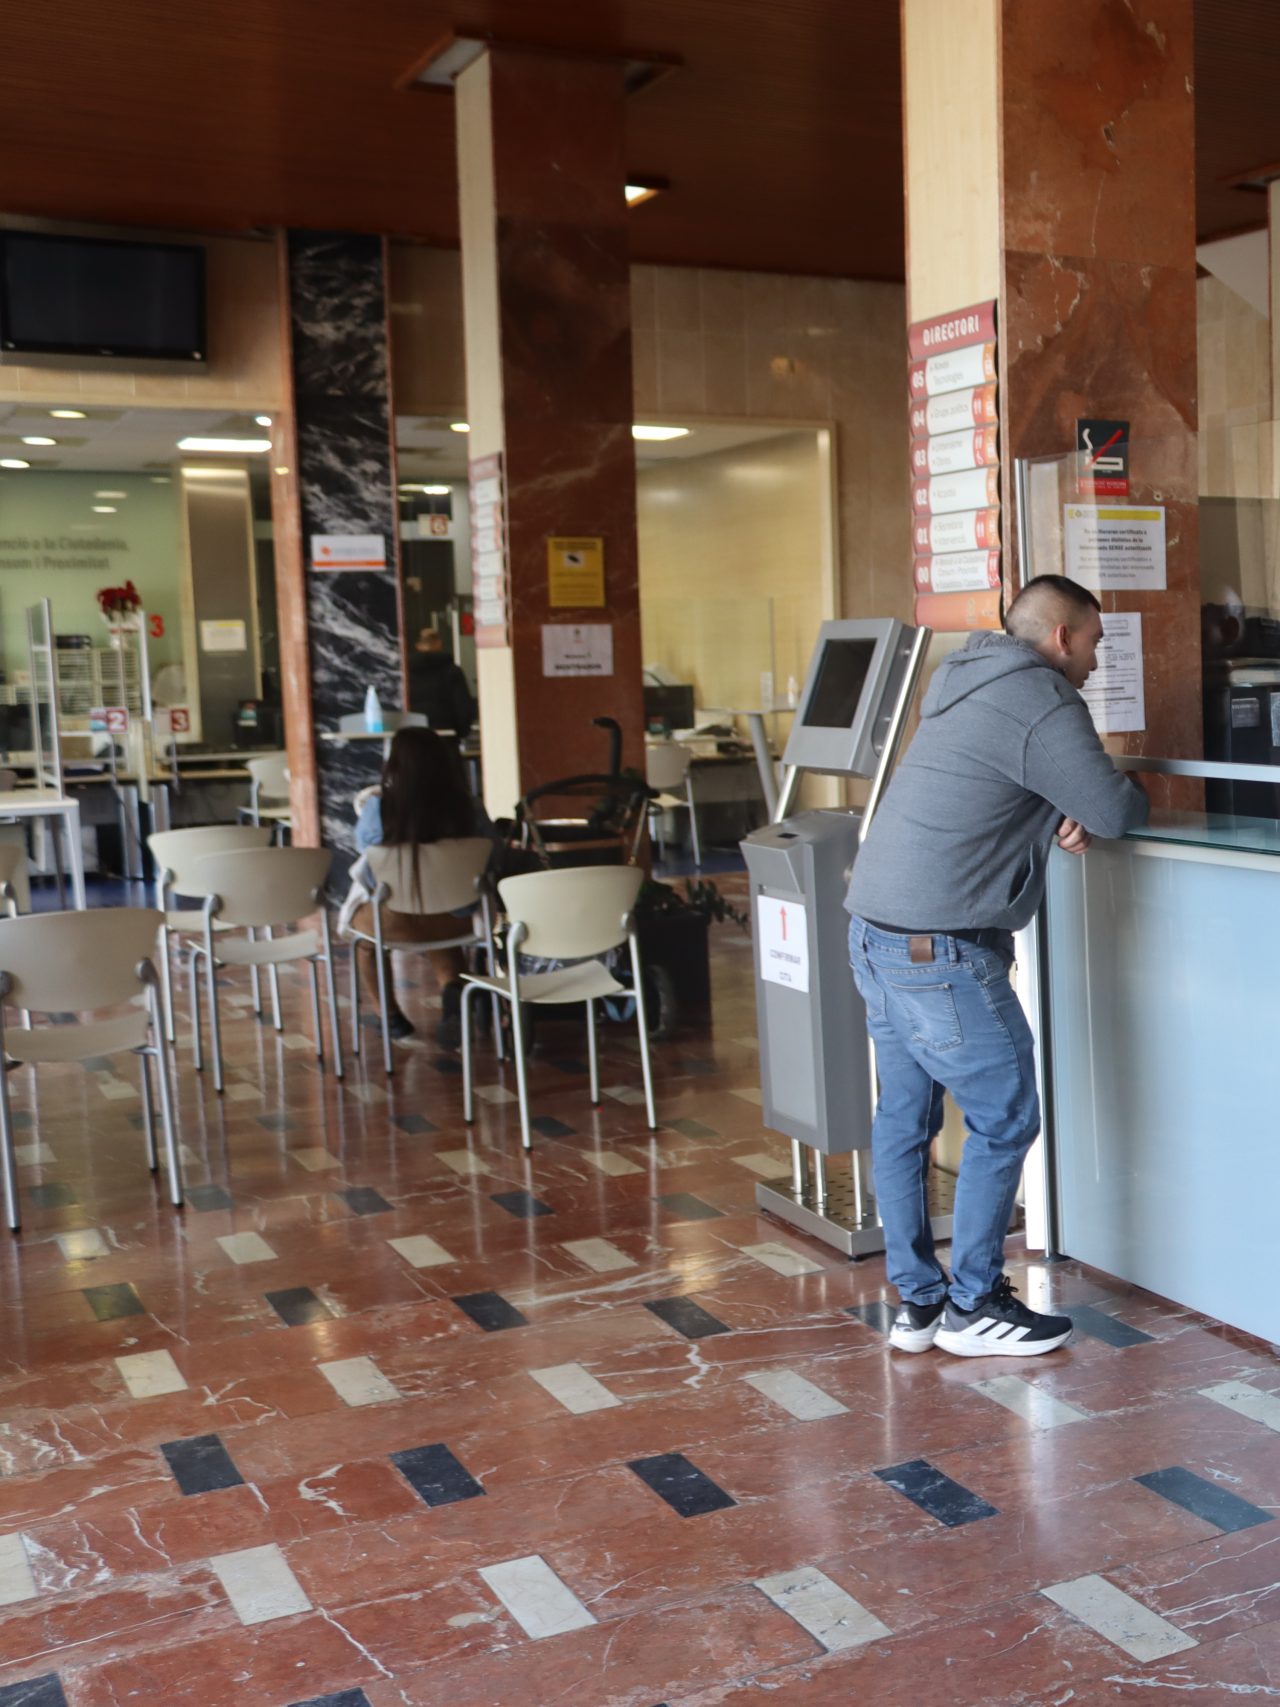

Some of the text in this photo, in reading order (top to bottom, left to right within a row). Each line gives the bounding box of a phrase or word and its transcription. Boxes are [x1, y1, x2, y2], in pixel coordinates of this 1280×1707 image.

[923, 314, 979, 346] DIRECTORI
[912, 370, 924, 388] 05
[149, 614, 164, 638] 3
[109, 712, 125, 731] 2
